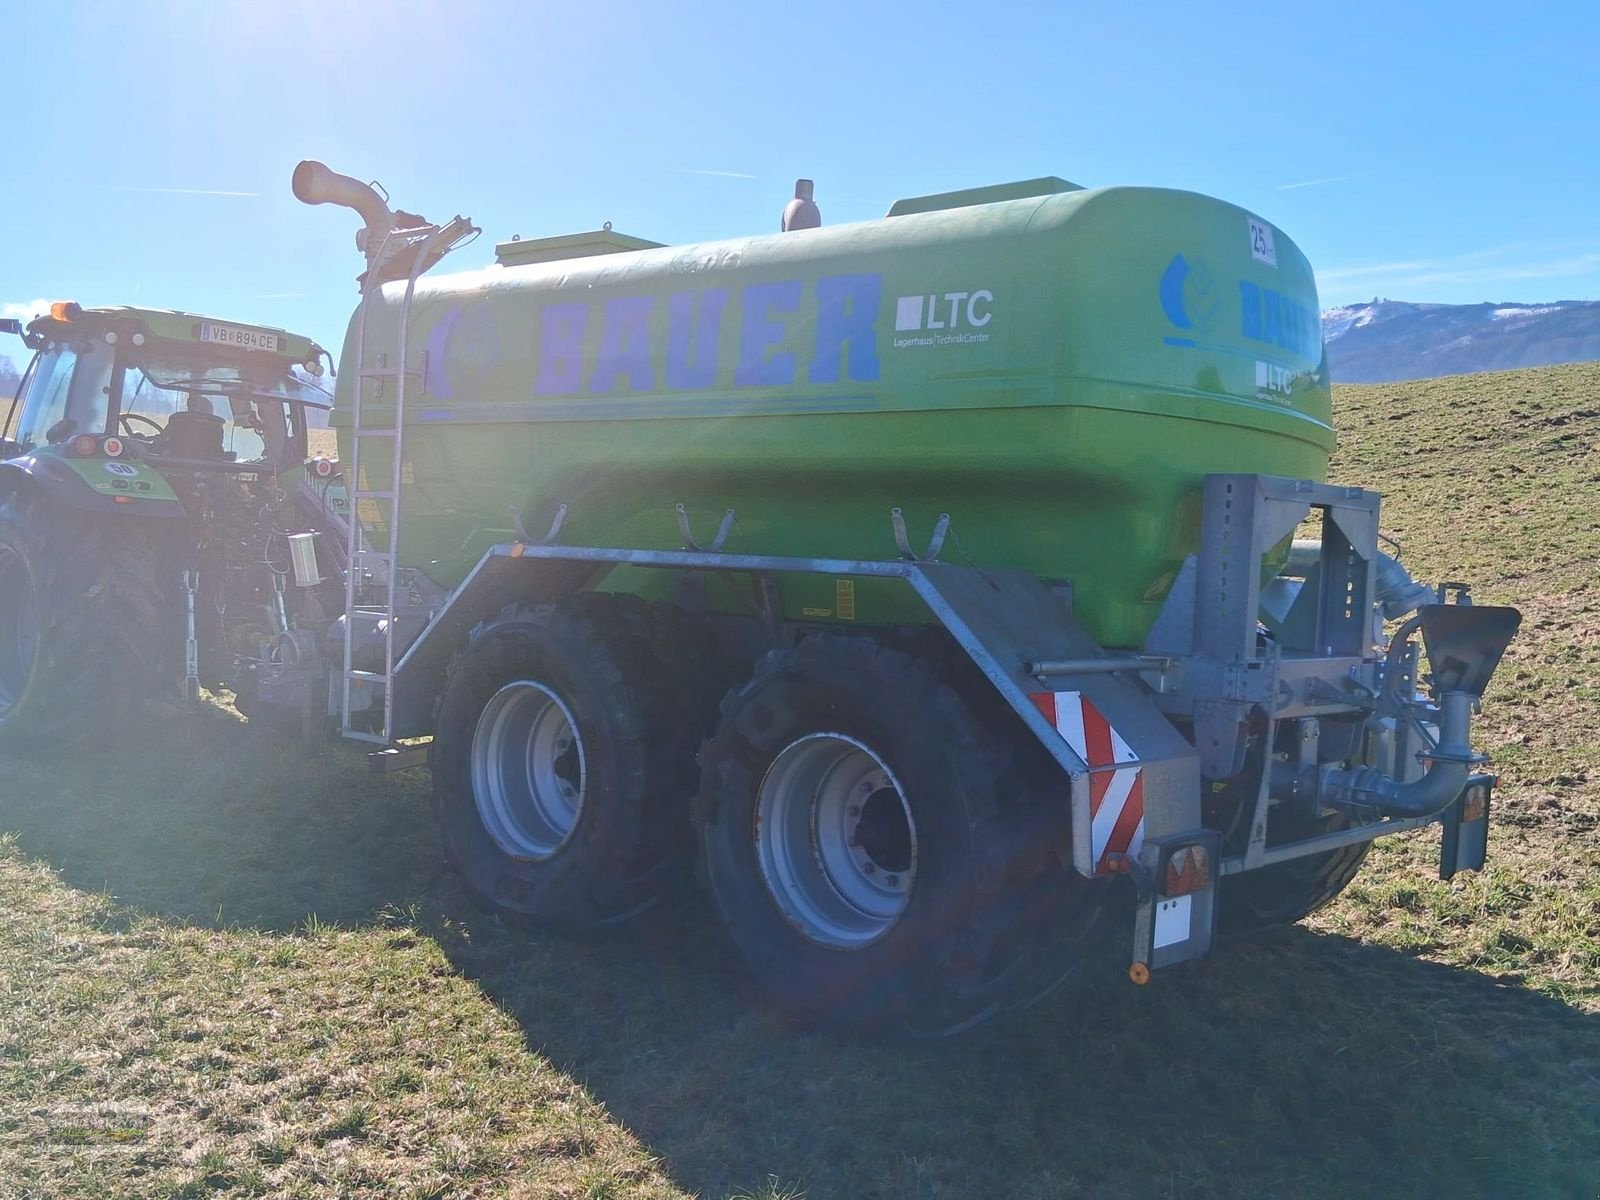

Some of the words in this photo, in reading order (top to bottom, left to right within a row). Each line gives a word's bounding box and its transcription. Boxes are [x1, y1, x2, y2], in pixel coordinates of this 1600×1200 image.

[1251, 225, 1266, 255] 25
[927, 289, 994, 329] LTC
[213, 327, 227, 341] VB
[236, 331, 257, 347] 894
[259, 335, 273, 349] CE
[534, 273, 882, 395] BAUER
[893, 337, 934, 348] Lagerhaus
[936, 333, 990, 345] TechnikCenter
[1269, 364, 1292, 395] LTC
[109, 464, 134, 474] 50
